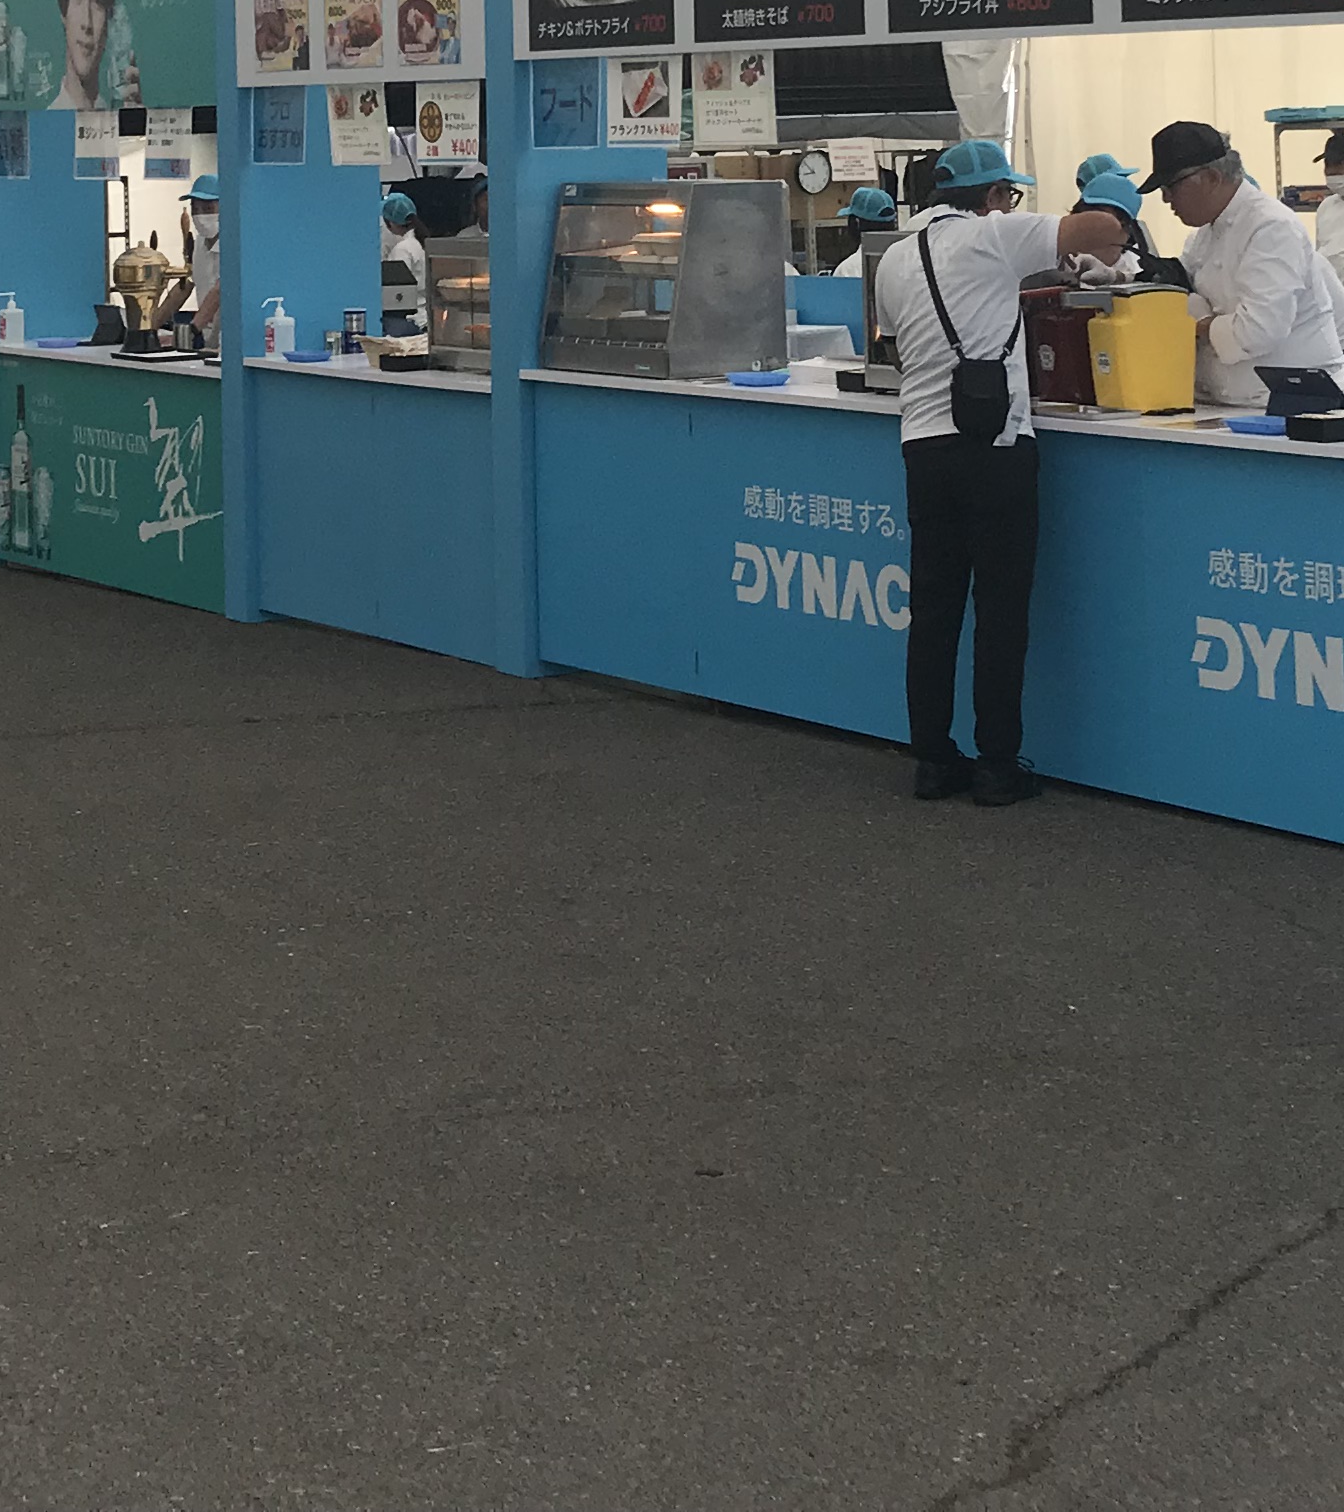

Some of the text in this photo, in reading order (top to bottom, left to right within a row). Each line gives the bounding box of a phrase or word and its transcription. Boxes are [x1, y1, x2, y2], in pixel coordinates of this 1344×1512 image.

[537, 16, 631, 40] チキン&ポテトフライ
[721, 4, 790, 28] 太麺焼きそば
[541, 84, 593, 122] フード
[610, 122, 680, 136] フランクフルト ¥400
[451, 138, 478, 156] ¥400
[72, 424, 125, 451] SUNTORY
[74, 452, 118, 500] SUI
[742, 485, 908, 542] 感動を調理する。
[730, 541, 912, 633] DYNAC
